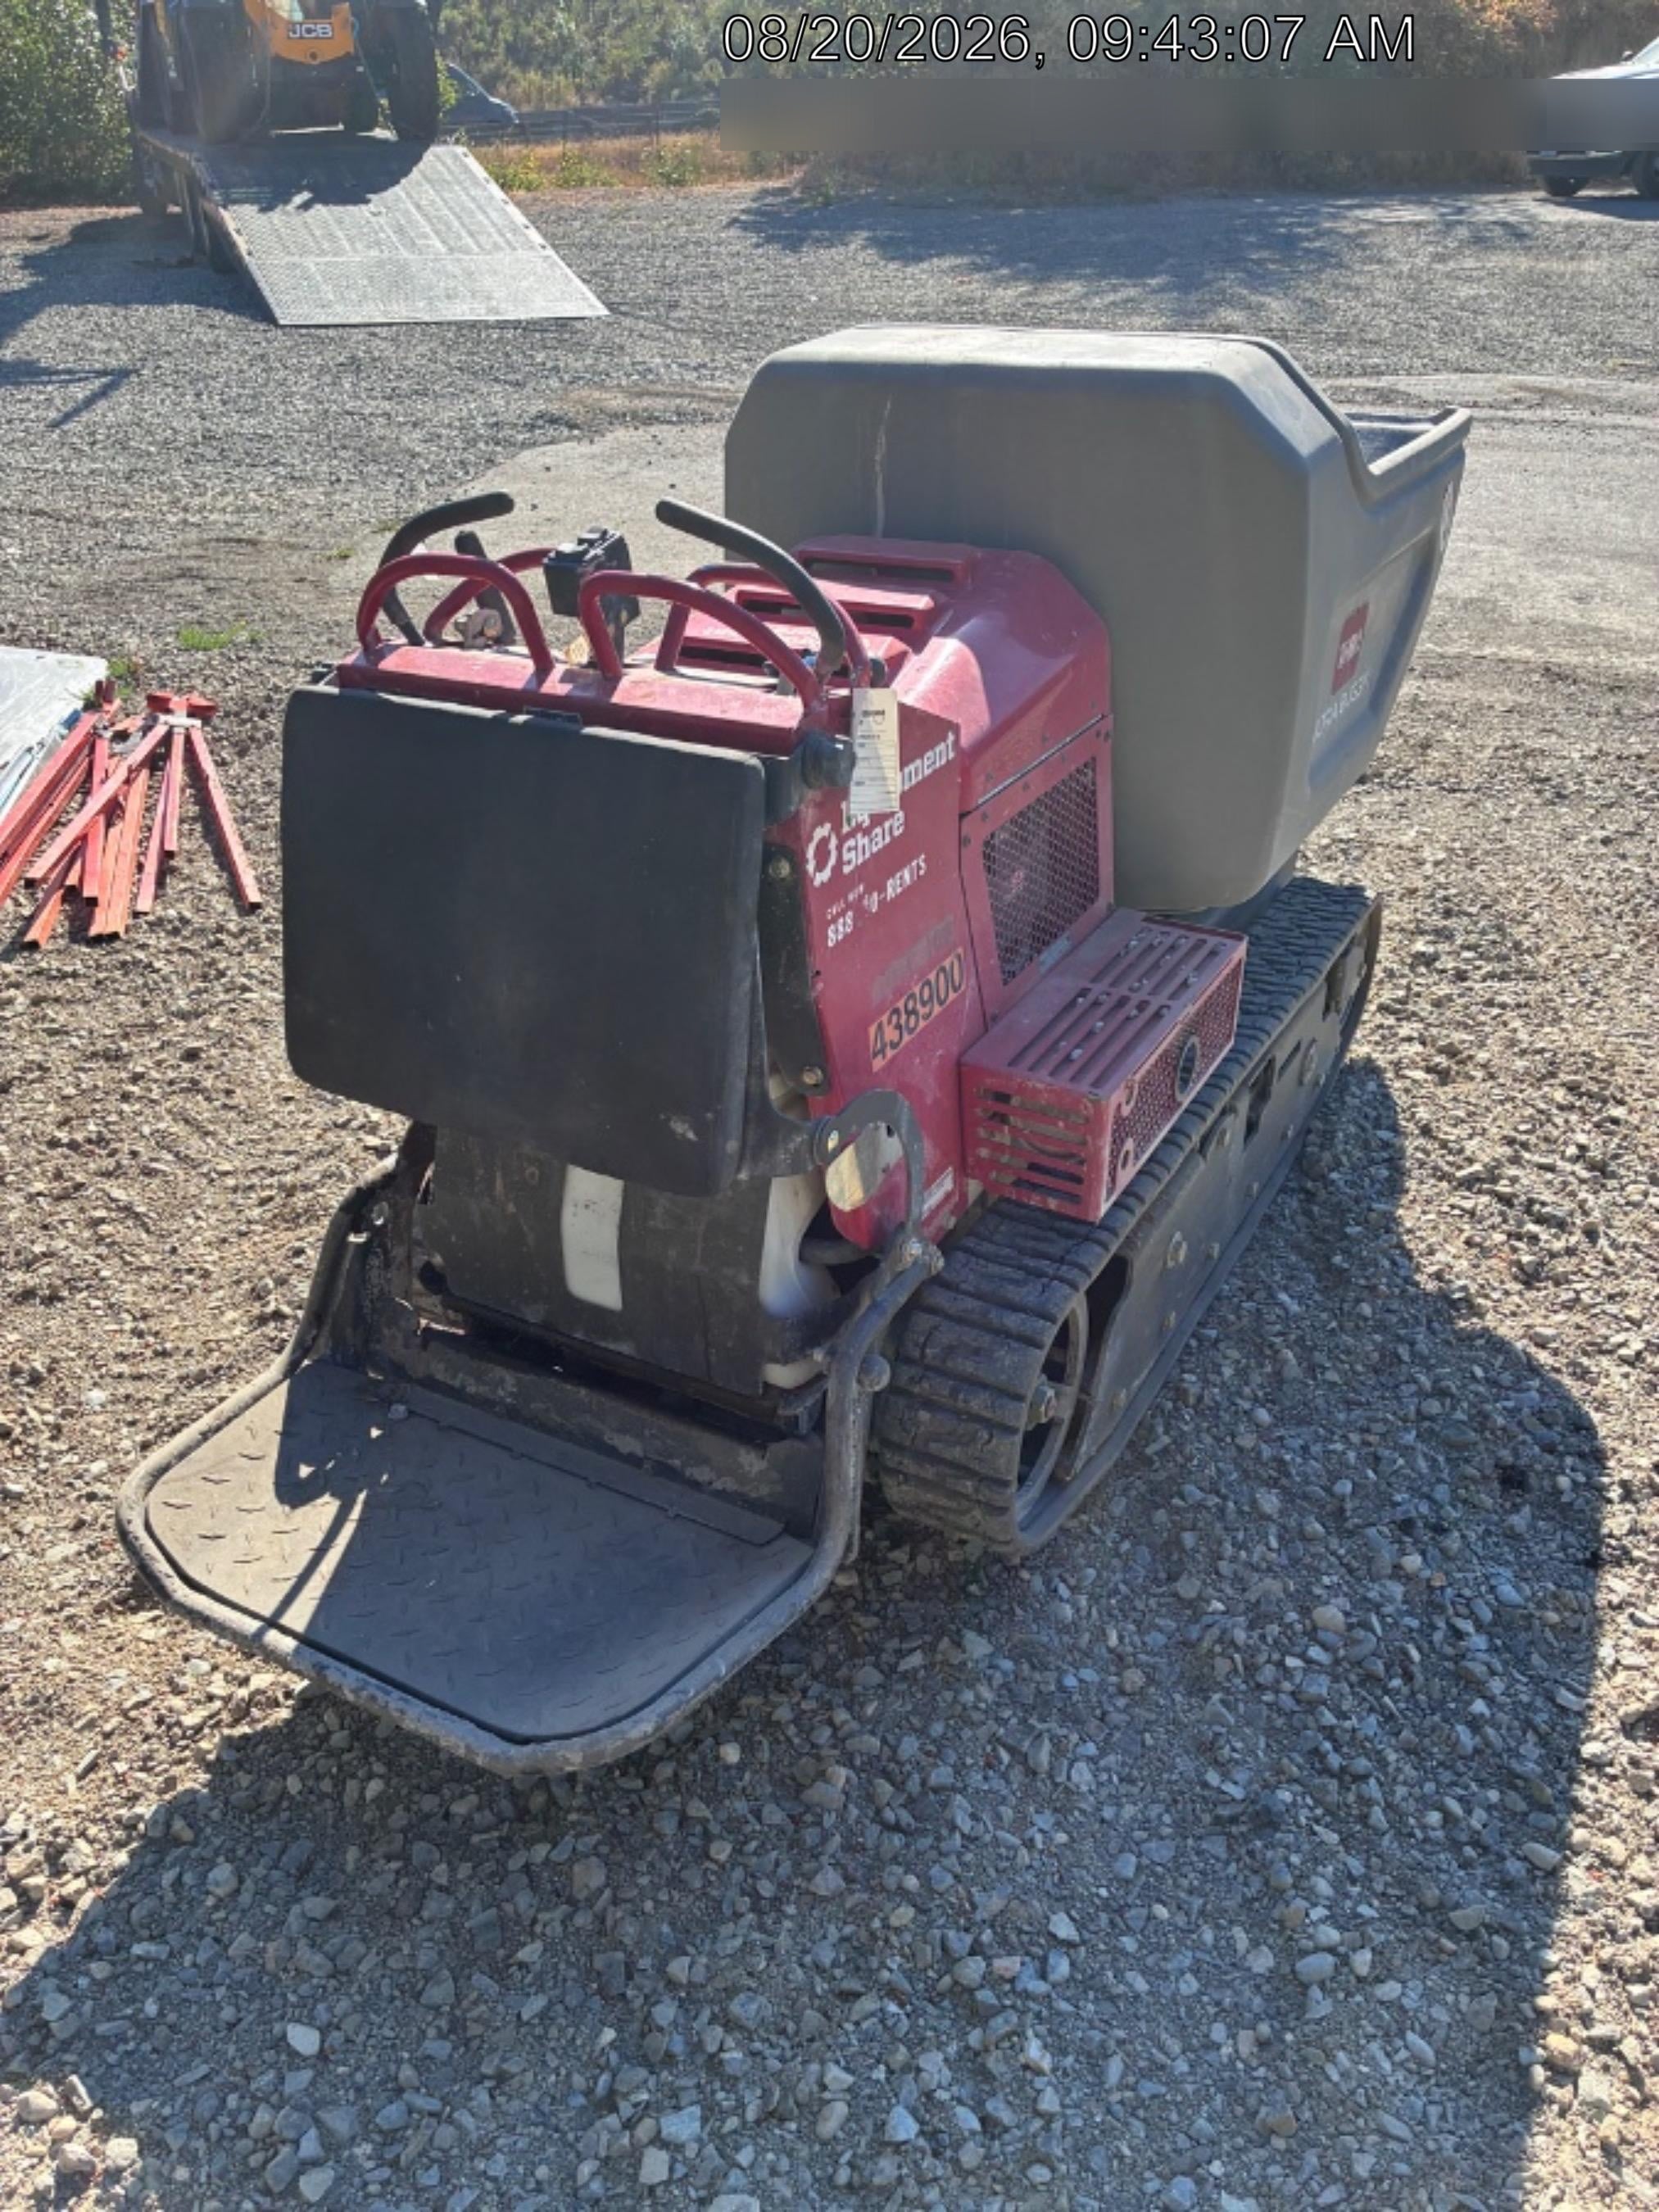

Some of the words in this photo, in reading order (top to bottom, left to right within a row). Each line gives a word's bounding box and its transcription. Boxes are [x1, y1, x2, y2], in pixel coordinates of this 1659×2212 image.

[288, 23, 333, 39] JCB
[842, 809, 906, 875] Share
[873, 953, 963, 1060] 438900
